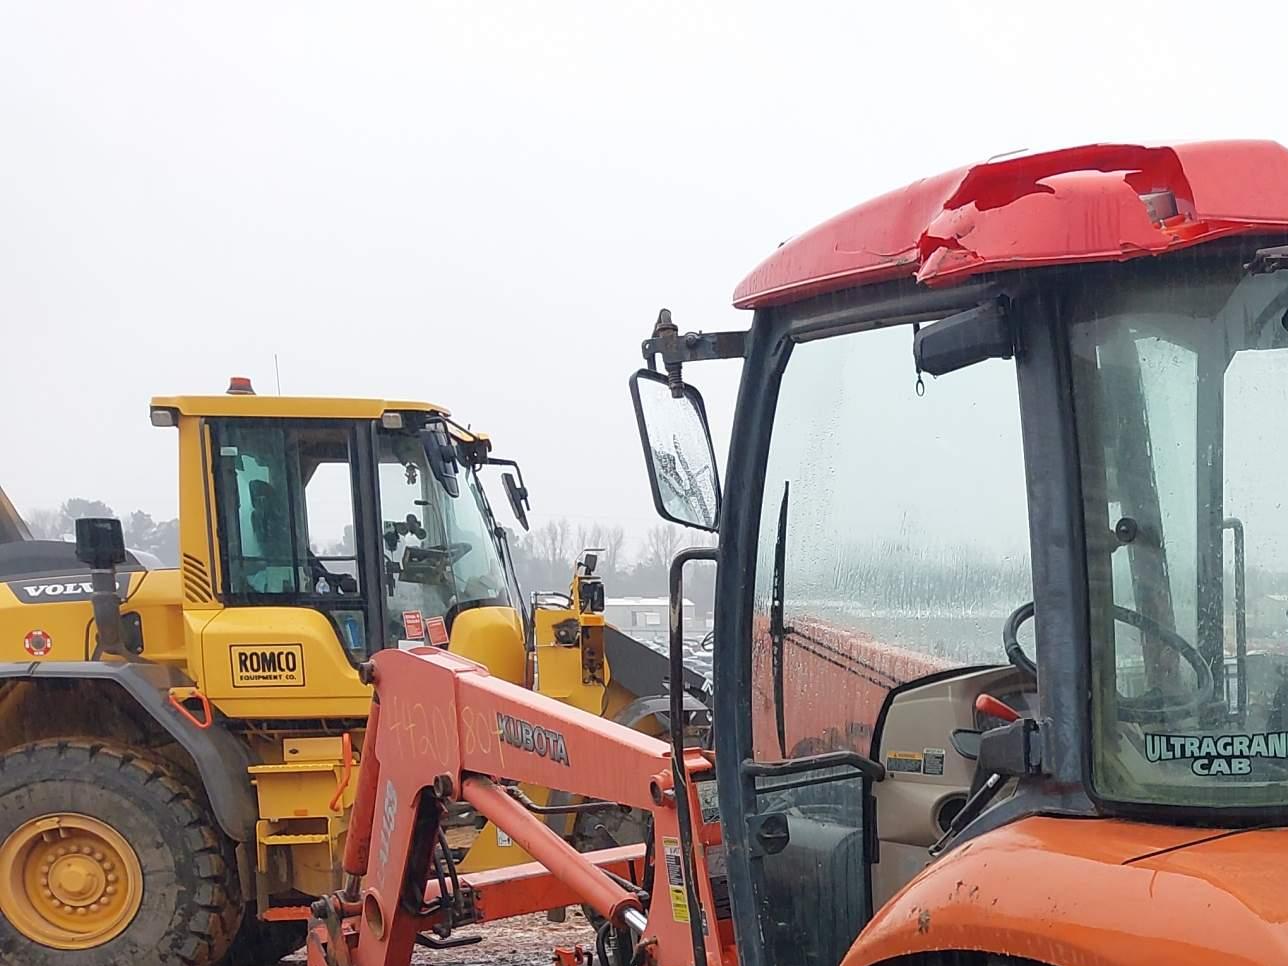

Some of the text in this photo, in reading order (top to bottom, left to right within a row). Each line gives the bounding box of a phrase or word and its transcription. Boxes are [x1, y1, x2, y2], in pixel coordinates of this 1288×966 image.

[23, 582, 120, 597] VOLV
[238, 651, 297, 673] ROMCO
[496, 711, 570, 767] KUBOTA
[1192, 757, 1252, 775] CAB
